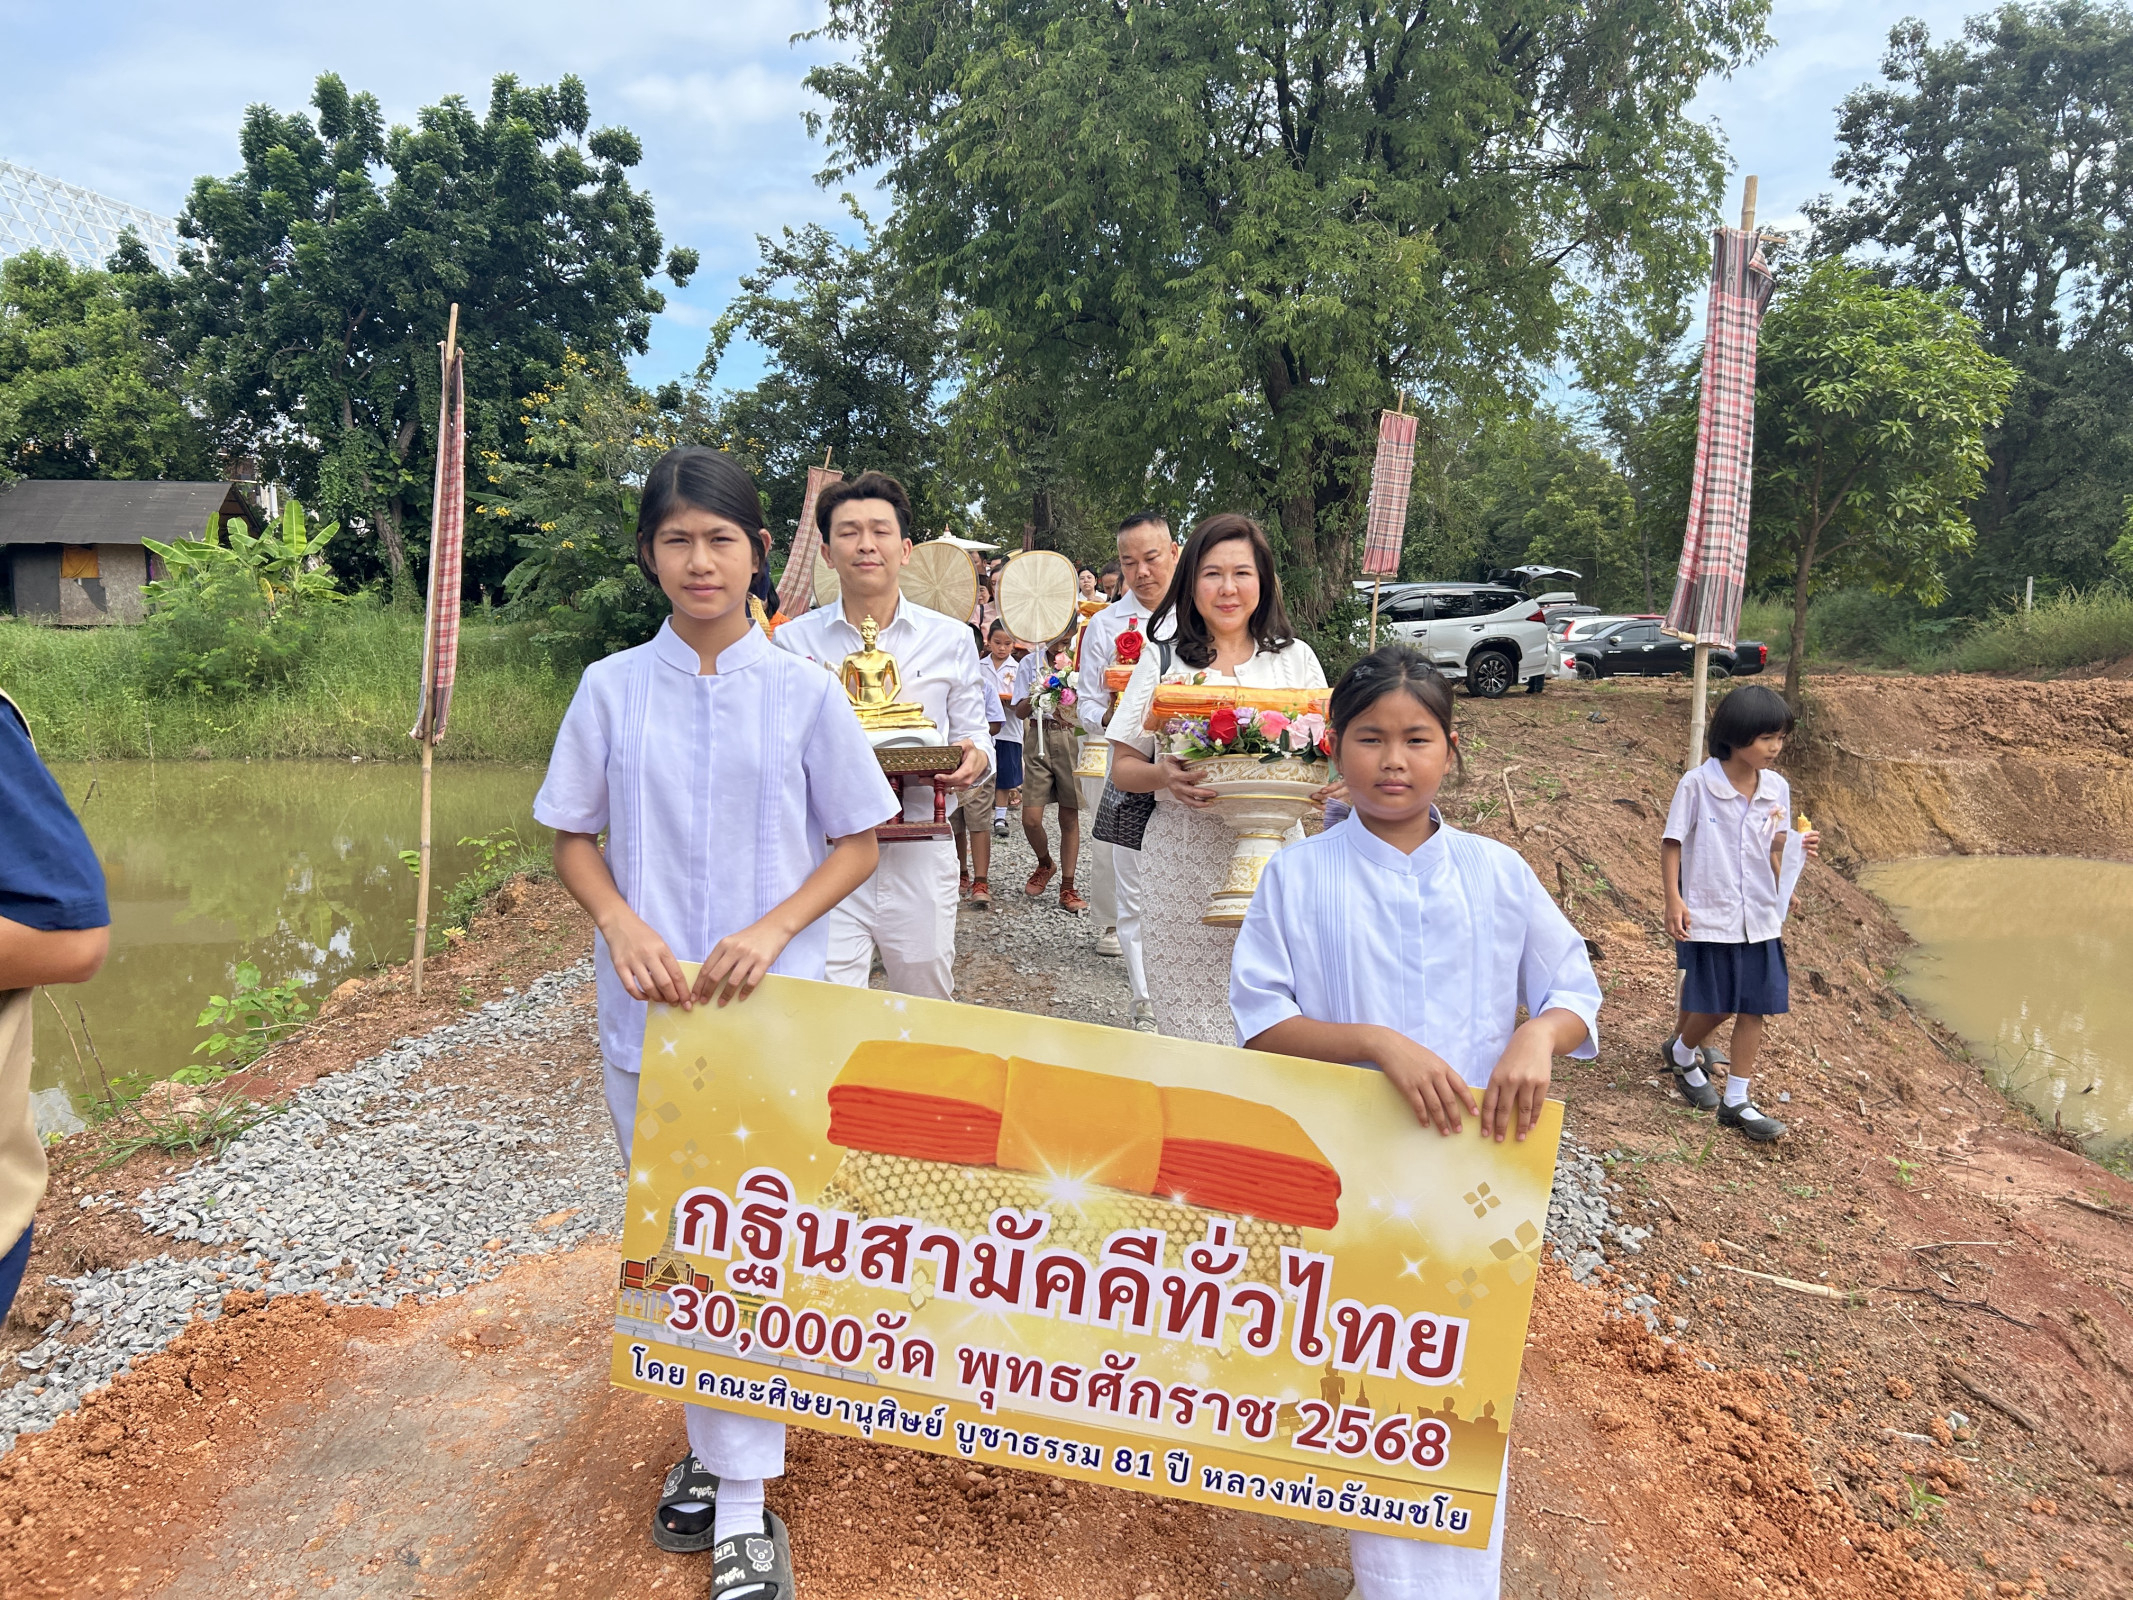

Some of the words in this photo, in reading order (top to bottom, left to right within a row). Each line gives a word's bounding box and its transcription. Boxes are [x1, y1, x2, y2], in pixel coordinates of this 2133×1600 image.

[682, 1173, 1460, 1379] กฐินสามัคคีทั่วไทย
[631, 1345, 685, 1386] โดย
[697, 1372, 943, 1437] คณะศิษยานุศิษย์
[958, 1423, 1101, 1467] บูชาธรรม
[1113, 1449, 1151, 1476] 81
[1167, 1451, 1190, 1484] ปี
[1204, 1469, 1469, 1532] หลวงพ่อธัมมชโย
[669, 1287, 936, 1378] 30,000วัด
[957, 1346, 1276, 1439] พุทธศักราช
[1296, 1402, 1447, 1468] 2568
